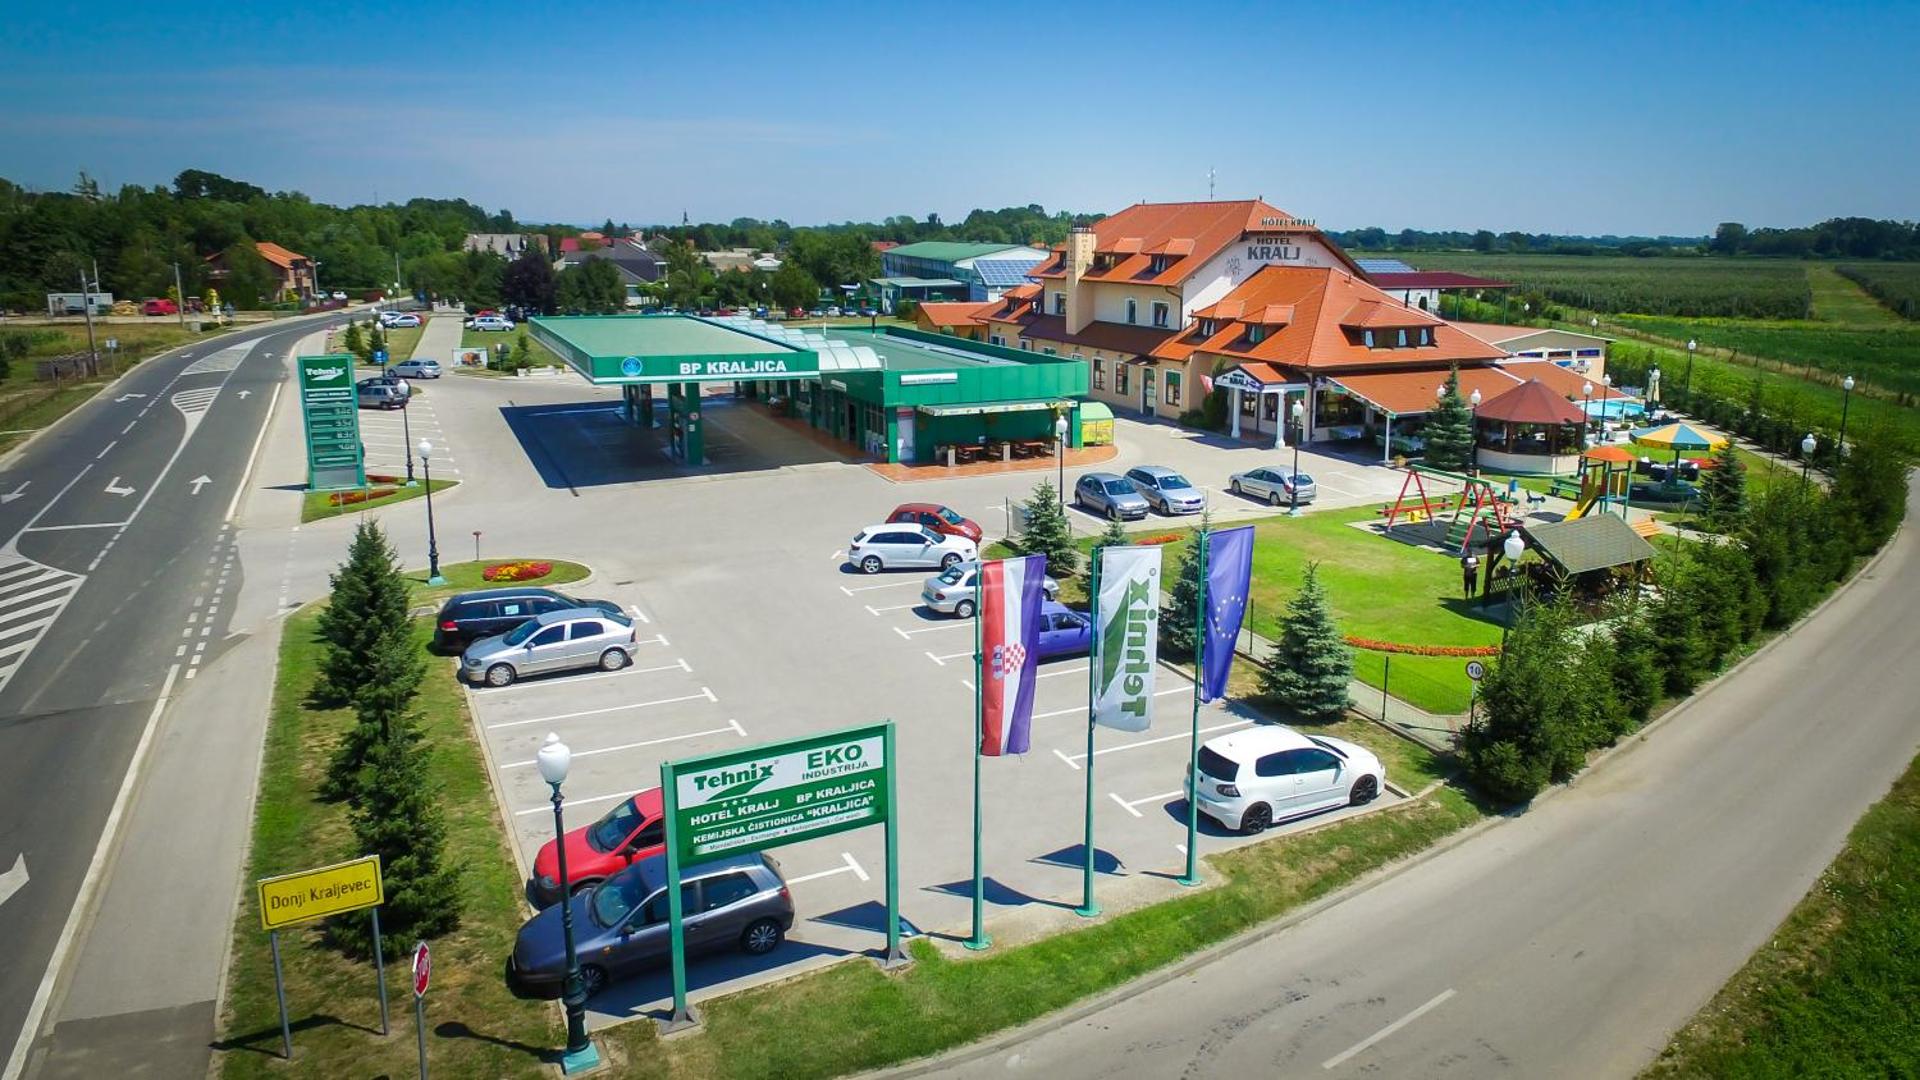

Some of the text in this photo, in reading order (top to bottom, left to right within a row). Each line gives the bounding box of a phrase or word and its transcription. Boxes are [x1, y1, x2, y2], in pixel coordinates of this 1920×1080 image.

[1261, 218, 1316, 226] HOTEL KRALJ
[1256, 237, 1292, 245] HOTEL
[1247, 246, 1301, 260] KRALJ
[680, 360, 787, 375] BP KRALJICA
[1469, 665, 1481, 676] 10
[807, 744, 863, 770] EKO
[693, 762, 774, 791] Tehnix
[801, 760, 869, 781] INDUSTRIJA
[796, 778, 876, 804] BP KRALJICA
[690, 798, 780, 826] HOTEL KRALJ
[693, 825, 746, 844] KEMIJSKA
[271, 879, 371, 910] Donji Kraljevec
